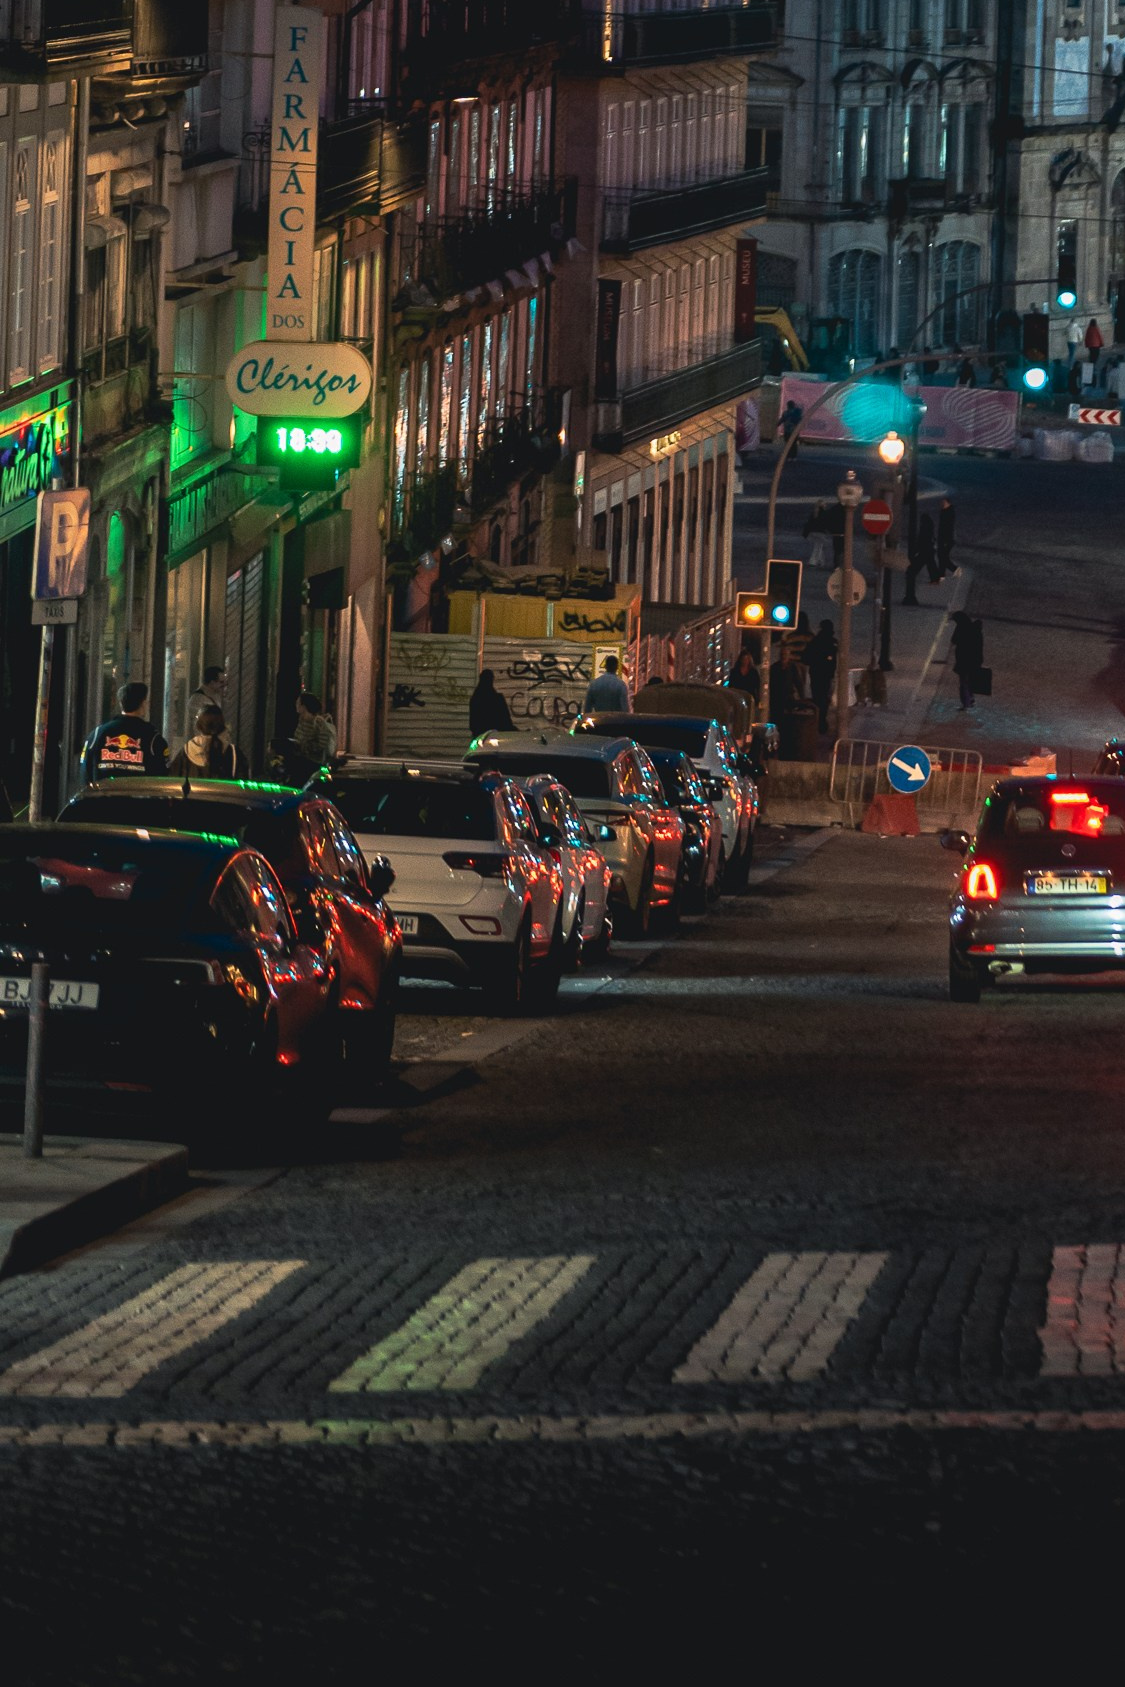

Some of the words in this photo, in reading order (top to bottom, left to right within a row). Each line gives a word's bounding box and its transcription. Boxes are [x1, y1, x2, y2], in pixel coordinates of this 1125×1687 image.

[276, 26, 312, 298] FARMÁCIA
[741, 249, 752, 285] MUSEU
[272, 314, 304, 328] DOS
[236, 357, 361, 405] Clérigos
[101, 748, 122, 761] Red
[122, 749, 143, 763] Bull
